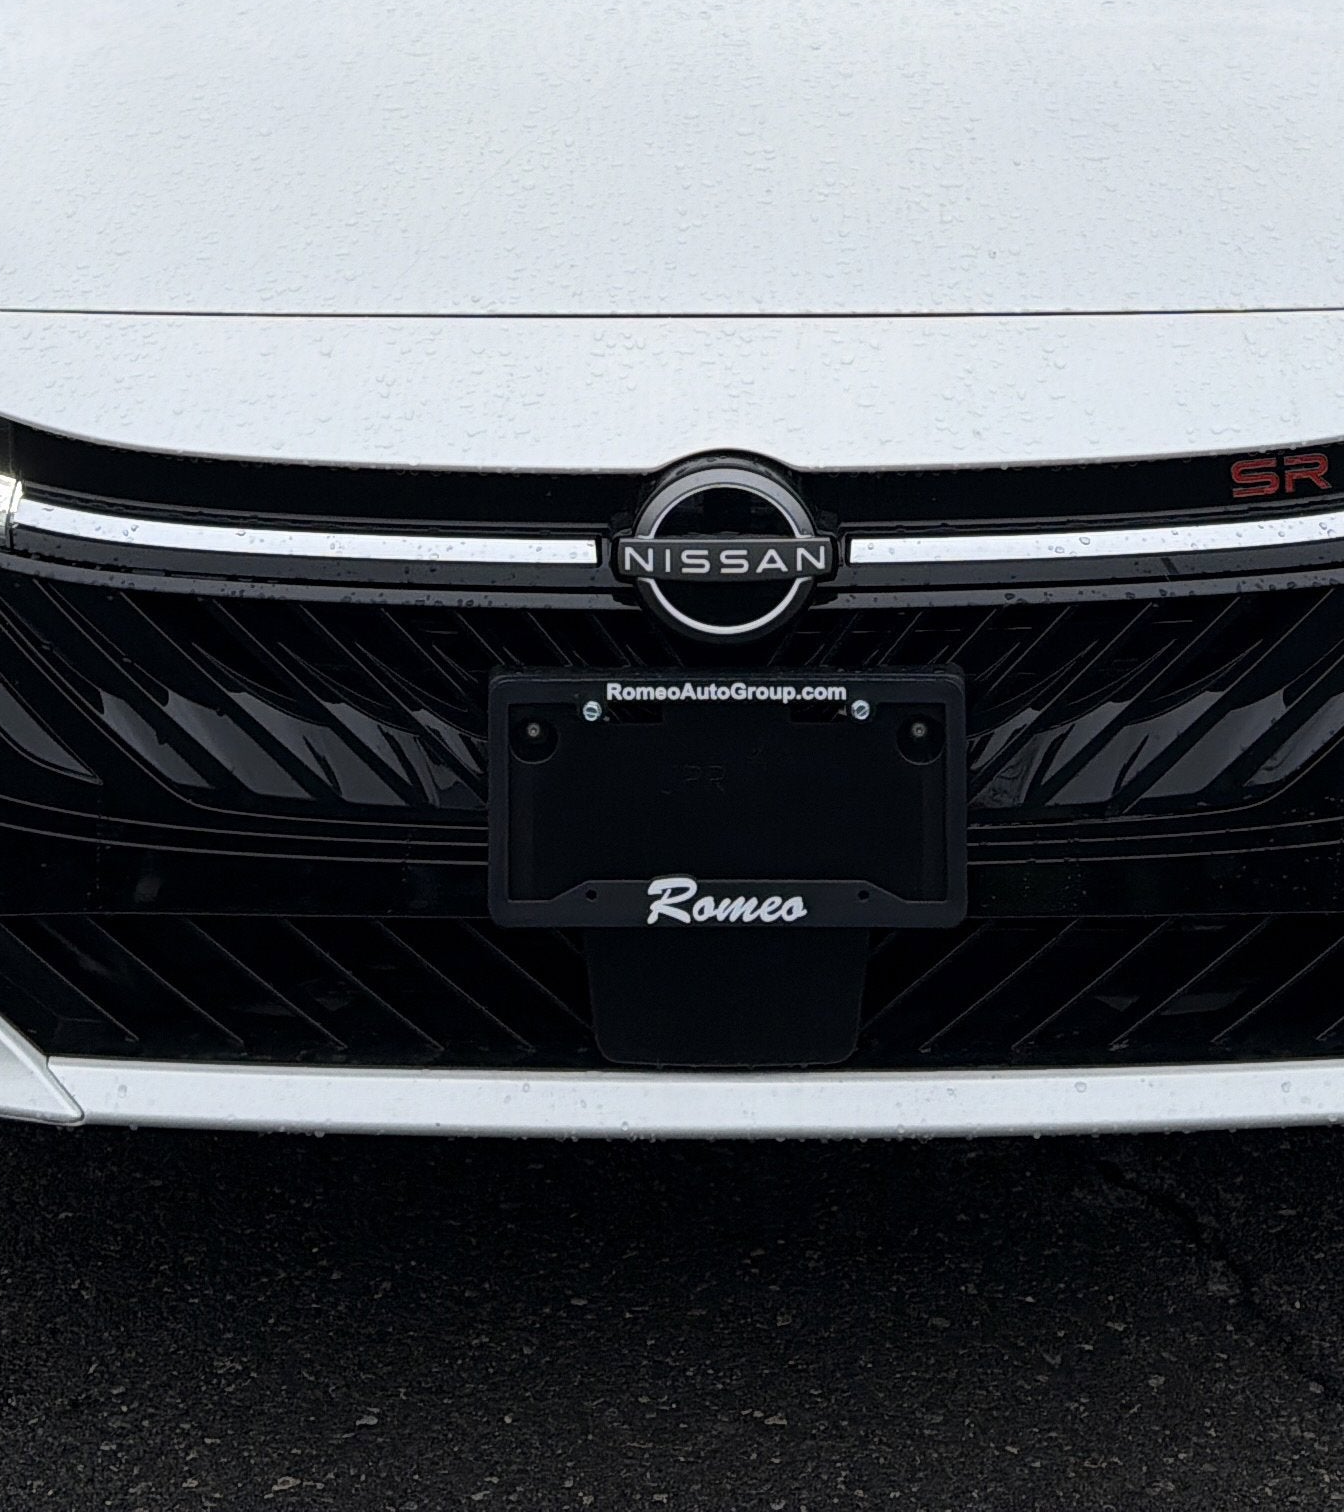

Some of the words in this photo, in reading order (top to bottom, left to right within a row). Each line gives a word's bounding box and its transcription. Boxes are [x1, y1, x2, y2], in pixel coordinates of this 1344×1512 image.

[1230, 453, 1332, 498] SR
[624, 545, 826, 574] NISSAN
[606, 682, 847, 704] RomeoAutoGroup.com
[646, 877, 808, 925] Romeo
